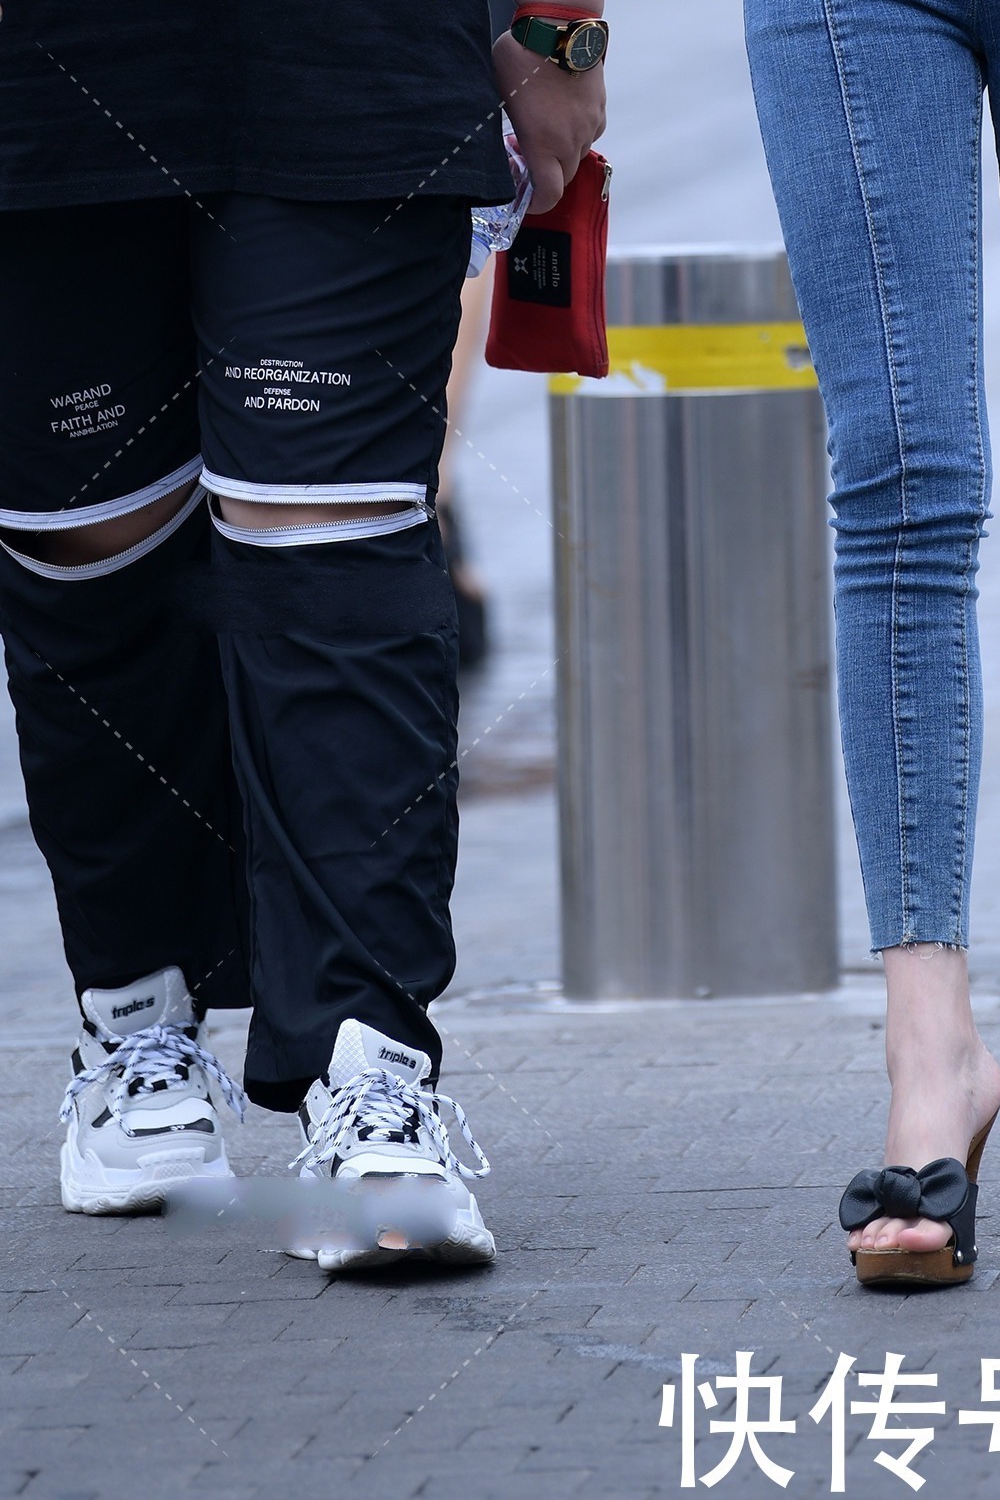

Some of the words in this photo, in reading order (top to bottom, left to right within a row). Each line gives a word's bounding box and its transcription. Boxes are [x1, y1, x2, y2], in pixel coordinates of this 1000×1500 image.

[551, 251, 560, 288] anello
[260, 358, 304, 368] DESTRUCTION
[224, 366, 242, 379] AND
[243, 367, 351, 386] REORGANIZATION
[263, 387, 292, 396] DEFENSE
[74, 400, 100, 412] PEACE
[244, 396, 265, 409] AND
[267, 397, 320, 412] PARDON
[50, 414, 93, 433] FAITH
[97, 404, 126, 423] AND
